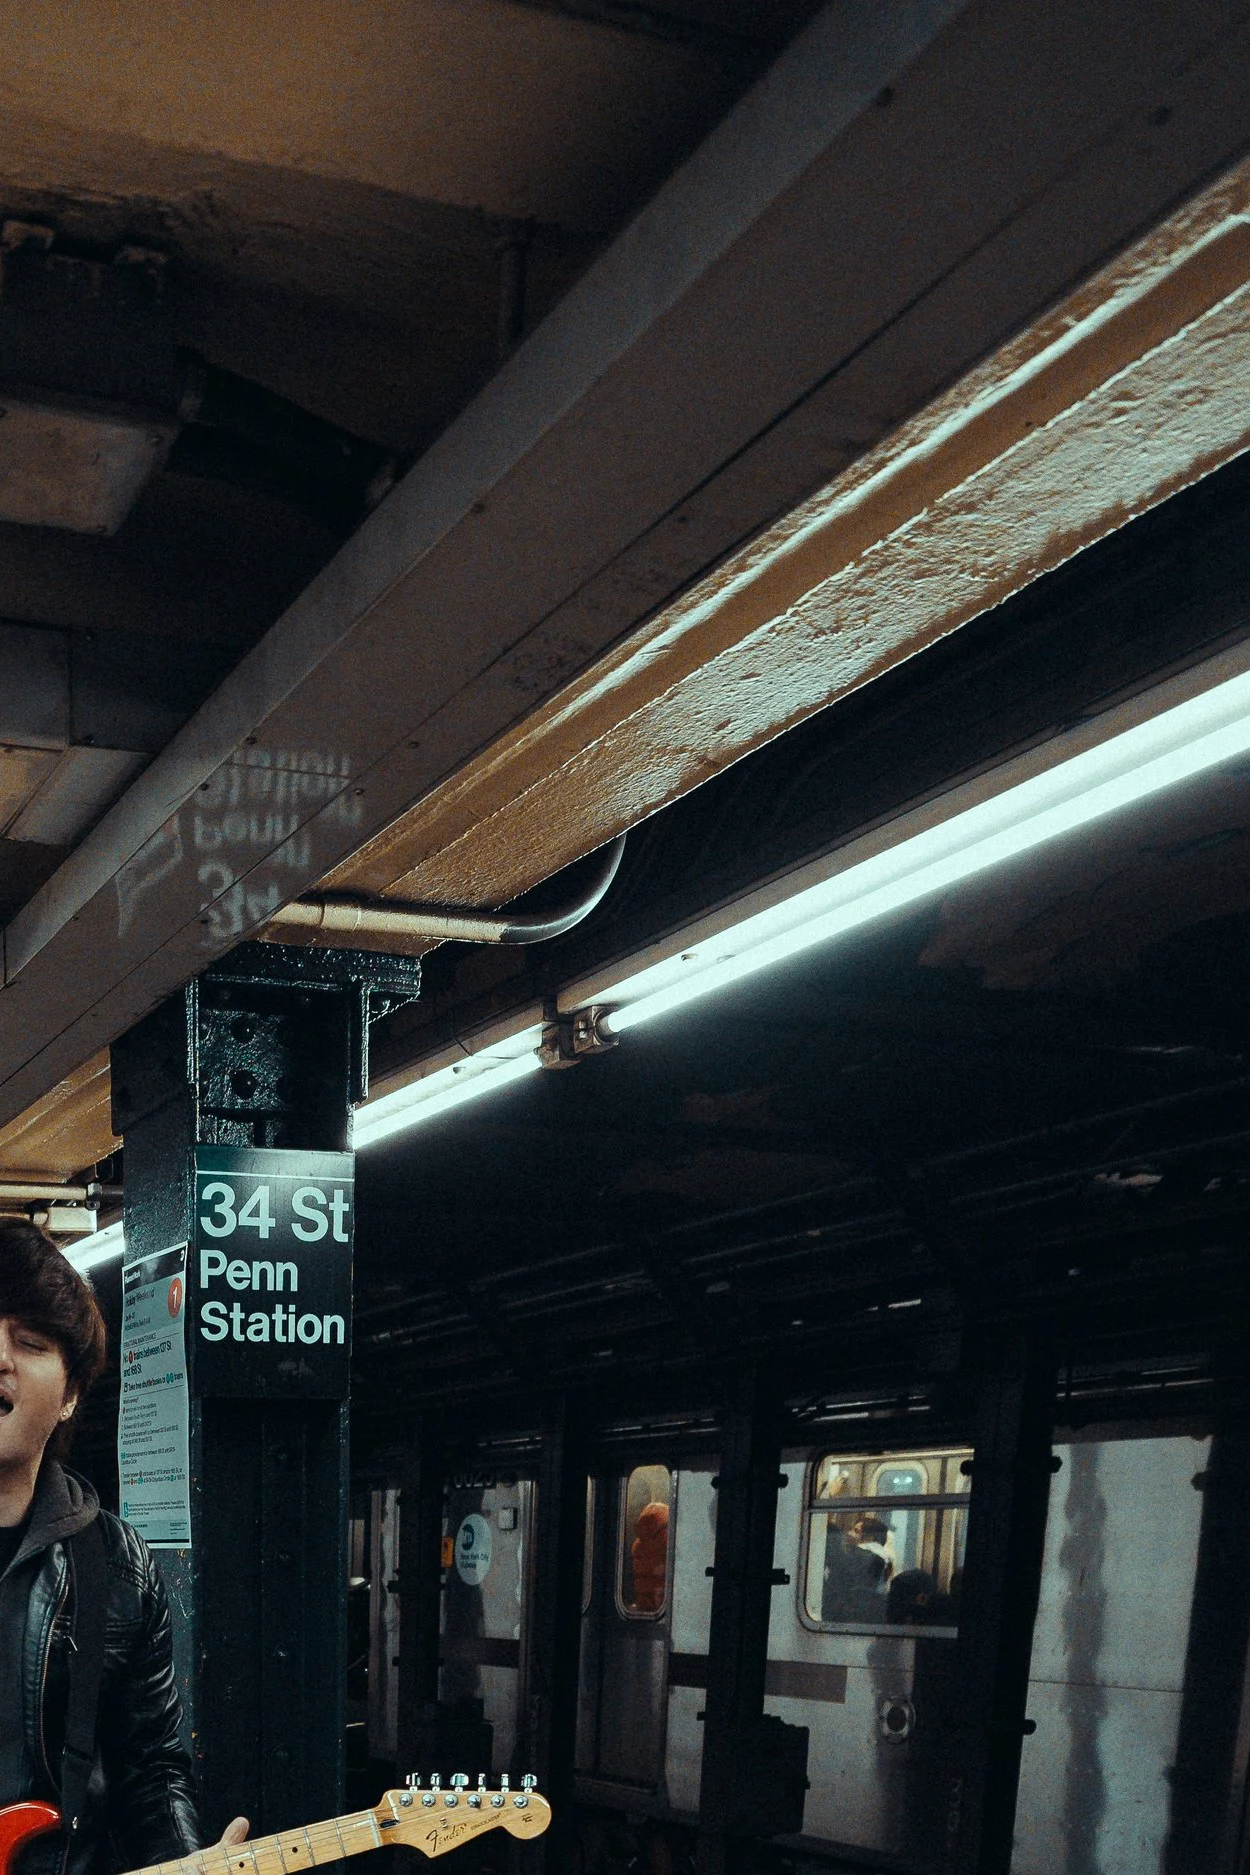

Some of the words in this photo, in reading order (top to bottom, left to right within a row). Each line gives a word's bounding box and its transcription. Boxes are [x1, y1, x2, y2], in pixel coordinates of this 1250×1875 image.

[200, 1181, 277, 1240] 34
[291, 1186, 350, 1243] St
[200, 1249, 298, 1292] Penn
[200, 1300, 345, 1344] Station
[425, 1823, 467, 1852] Fender
